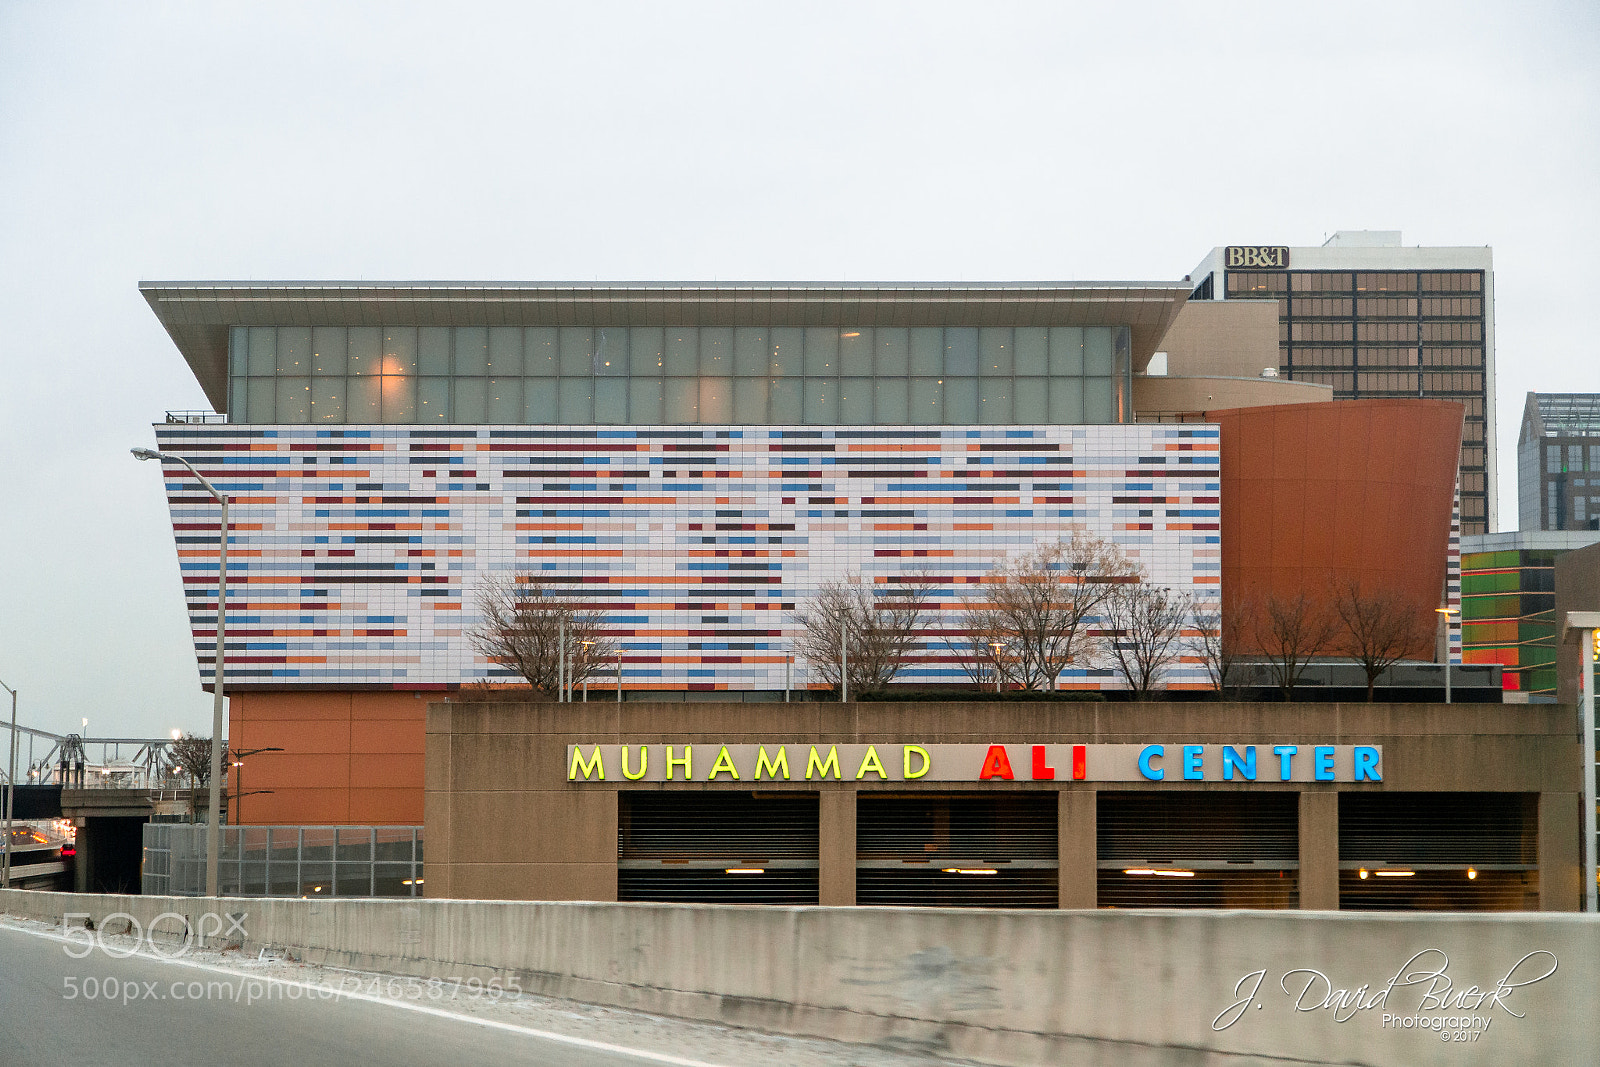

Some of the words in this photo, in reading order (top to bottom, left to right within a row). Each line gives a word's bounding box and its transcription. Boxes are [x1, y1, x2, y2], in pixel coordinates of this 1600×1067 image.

[1228, 247, 1288, 267] BB&T
[569, 745, 931, 780] MUHAMMAD
[979, 745, 1087, 780] ALI
[1138, 745, 1382, 781] CENTER
